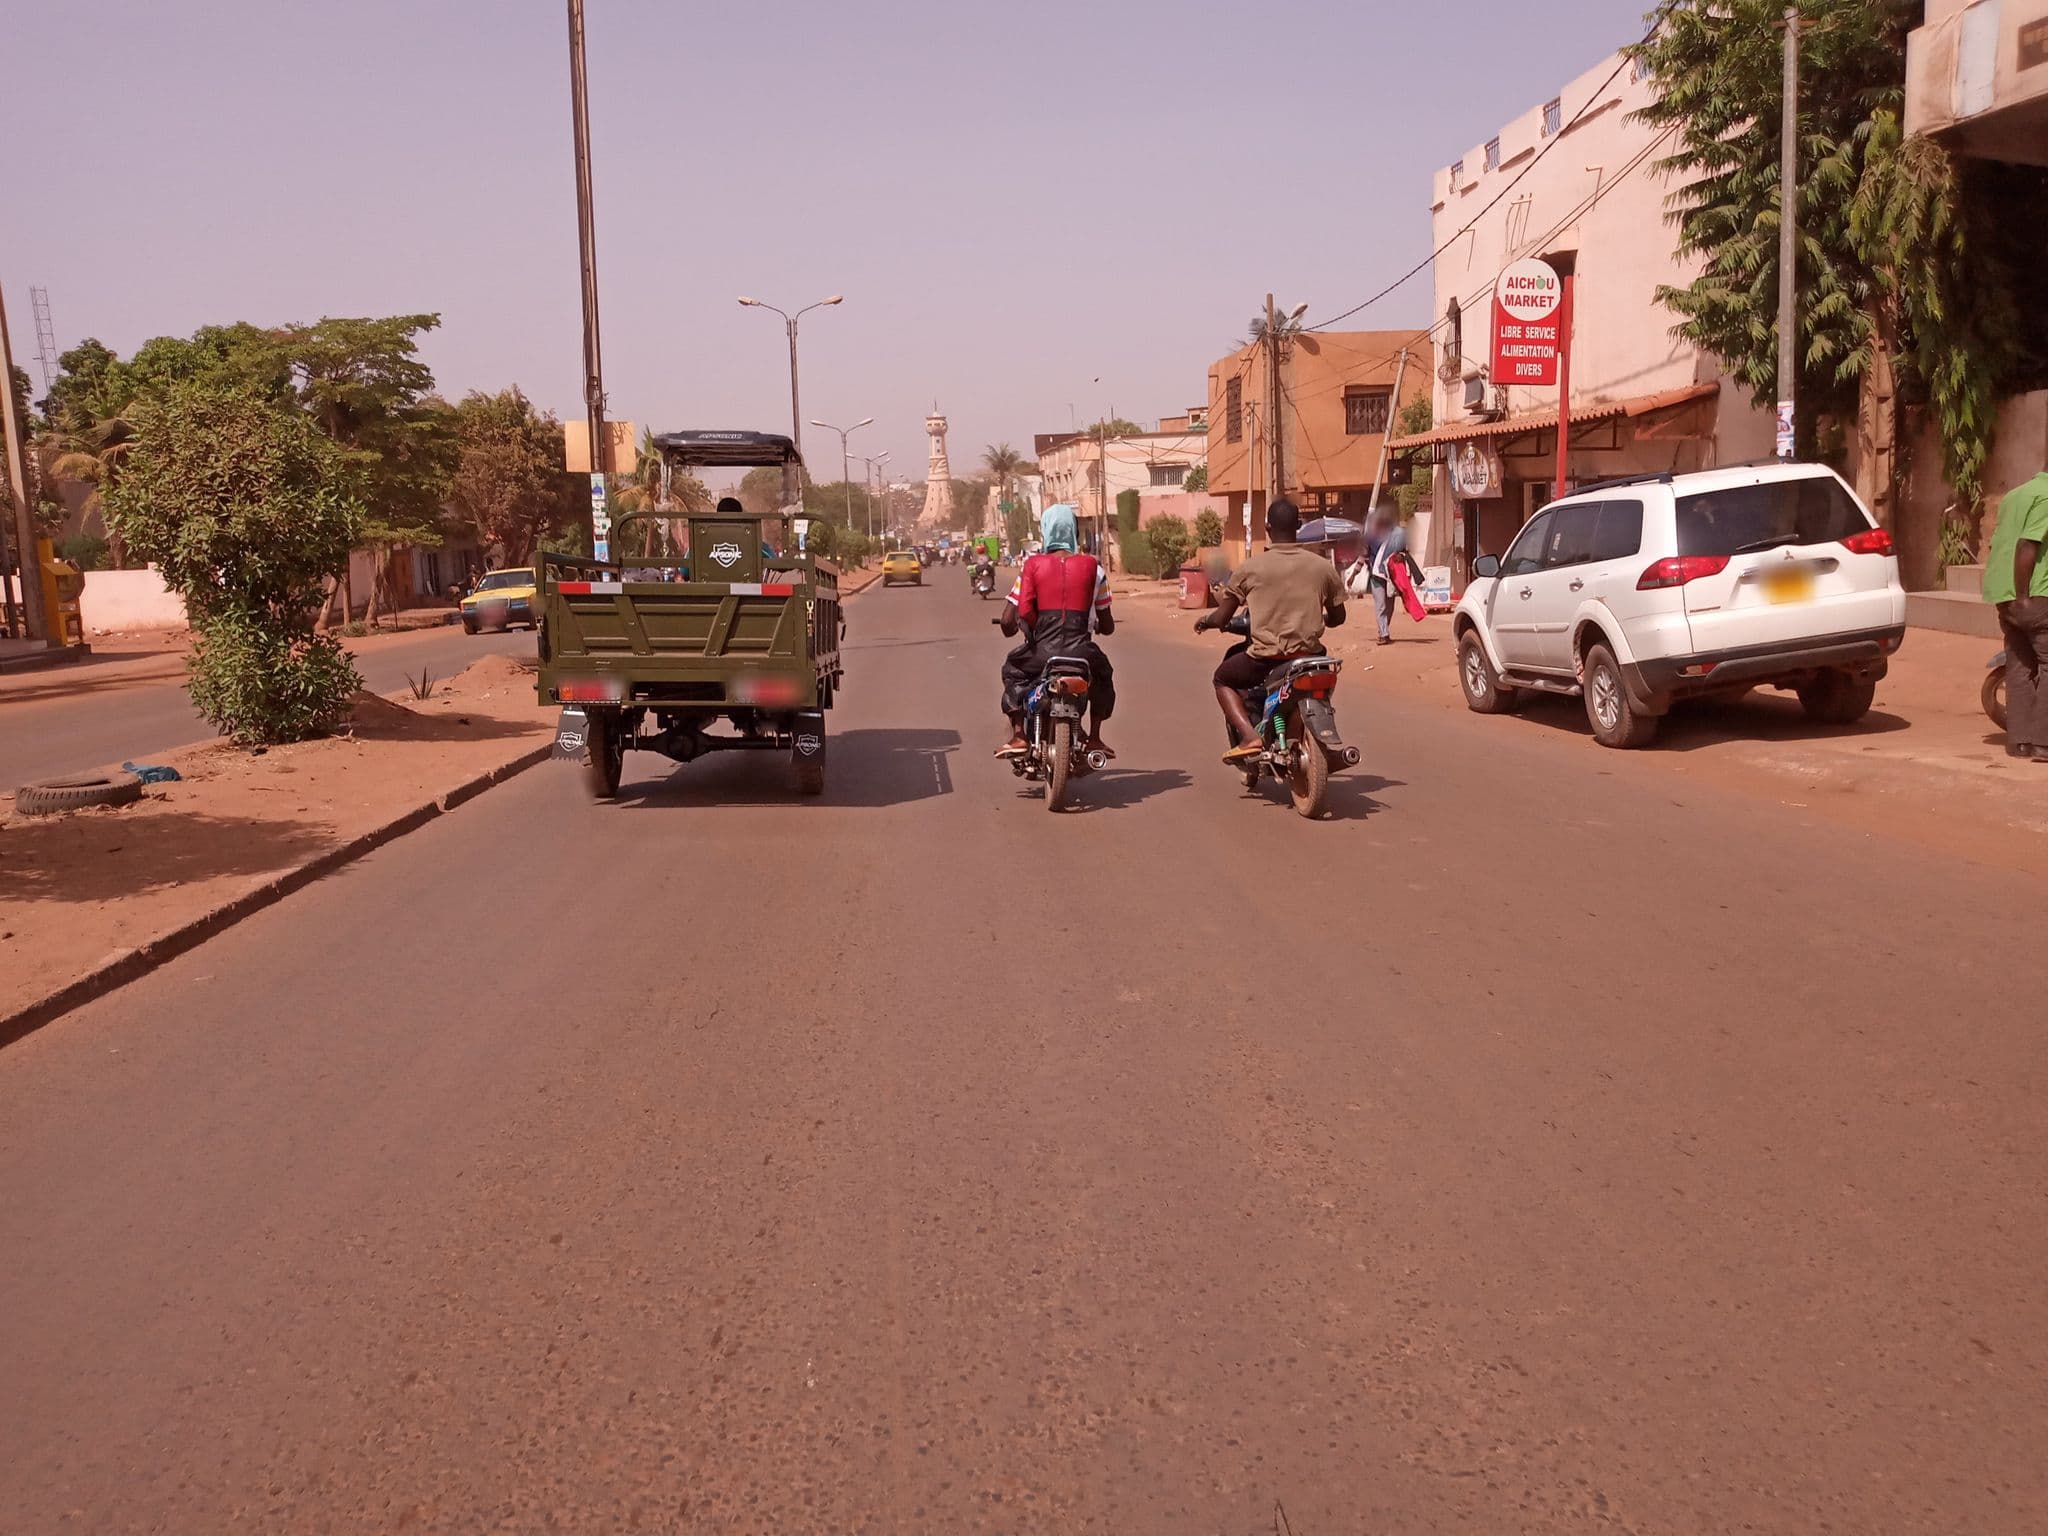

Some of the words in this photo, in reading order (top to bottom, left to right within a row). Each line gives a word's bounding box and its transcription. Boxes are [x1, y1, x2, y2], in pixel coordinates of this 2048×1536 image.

[1504, 294, 1555, 308] MARKET
[1500, 325, 1522, 339] LIBRE
[1525, 326, 1556, 340] SERVICE
[1501, 344, 1555, 358] ALIMENTATION
[1515, 363, 1543, 377] DIVERS
